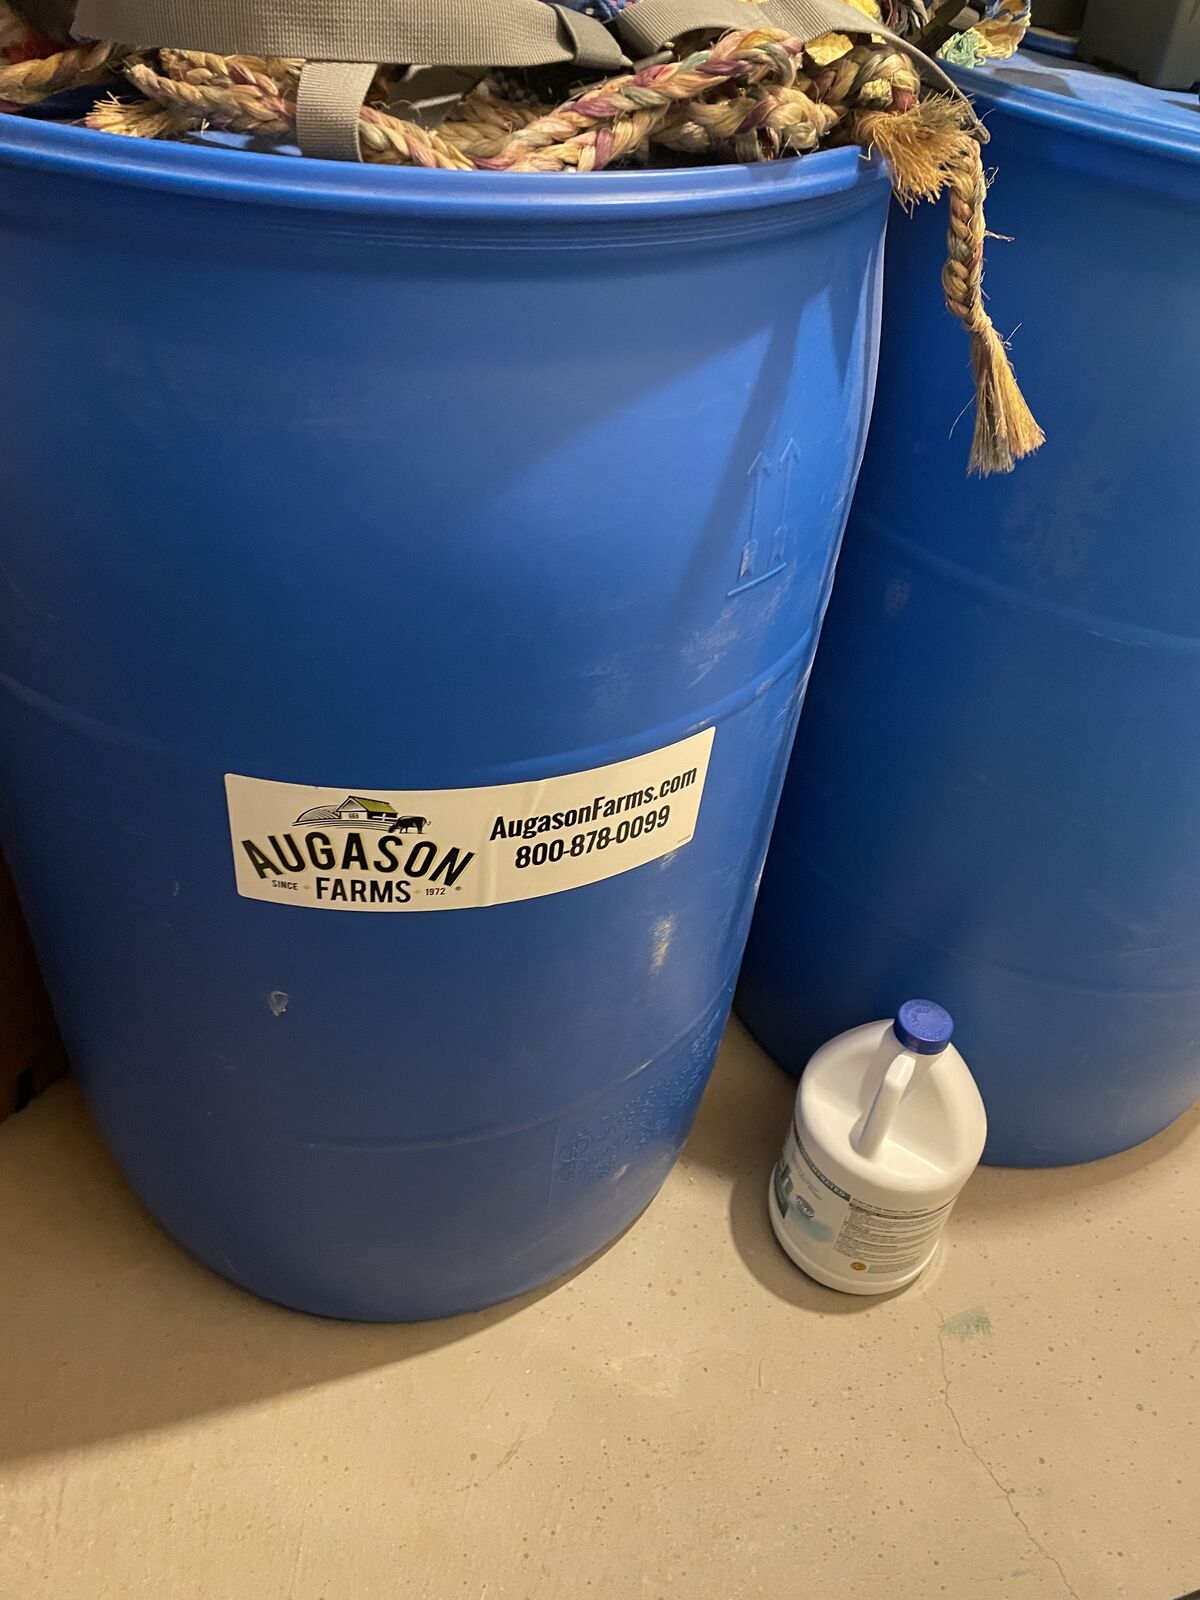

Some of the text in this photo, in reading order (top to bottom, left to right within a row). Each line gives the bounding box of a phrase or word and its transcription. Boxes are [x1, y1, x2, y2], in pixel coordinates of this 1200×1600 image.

[490, 767, 697, 841] AugasonFarms.com
[241, 831, 475, 887] AUGASON
[515, 805, 671, 869] 800-878-0099
[271, 879, 298, 891] SINCE
[316, 876, 411, 904] FARMS
[425, 887, 446, 896] 1972
